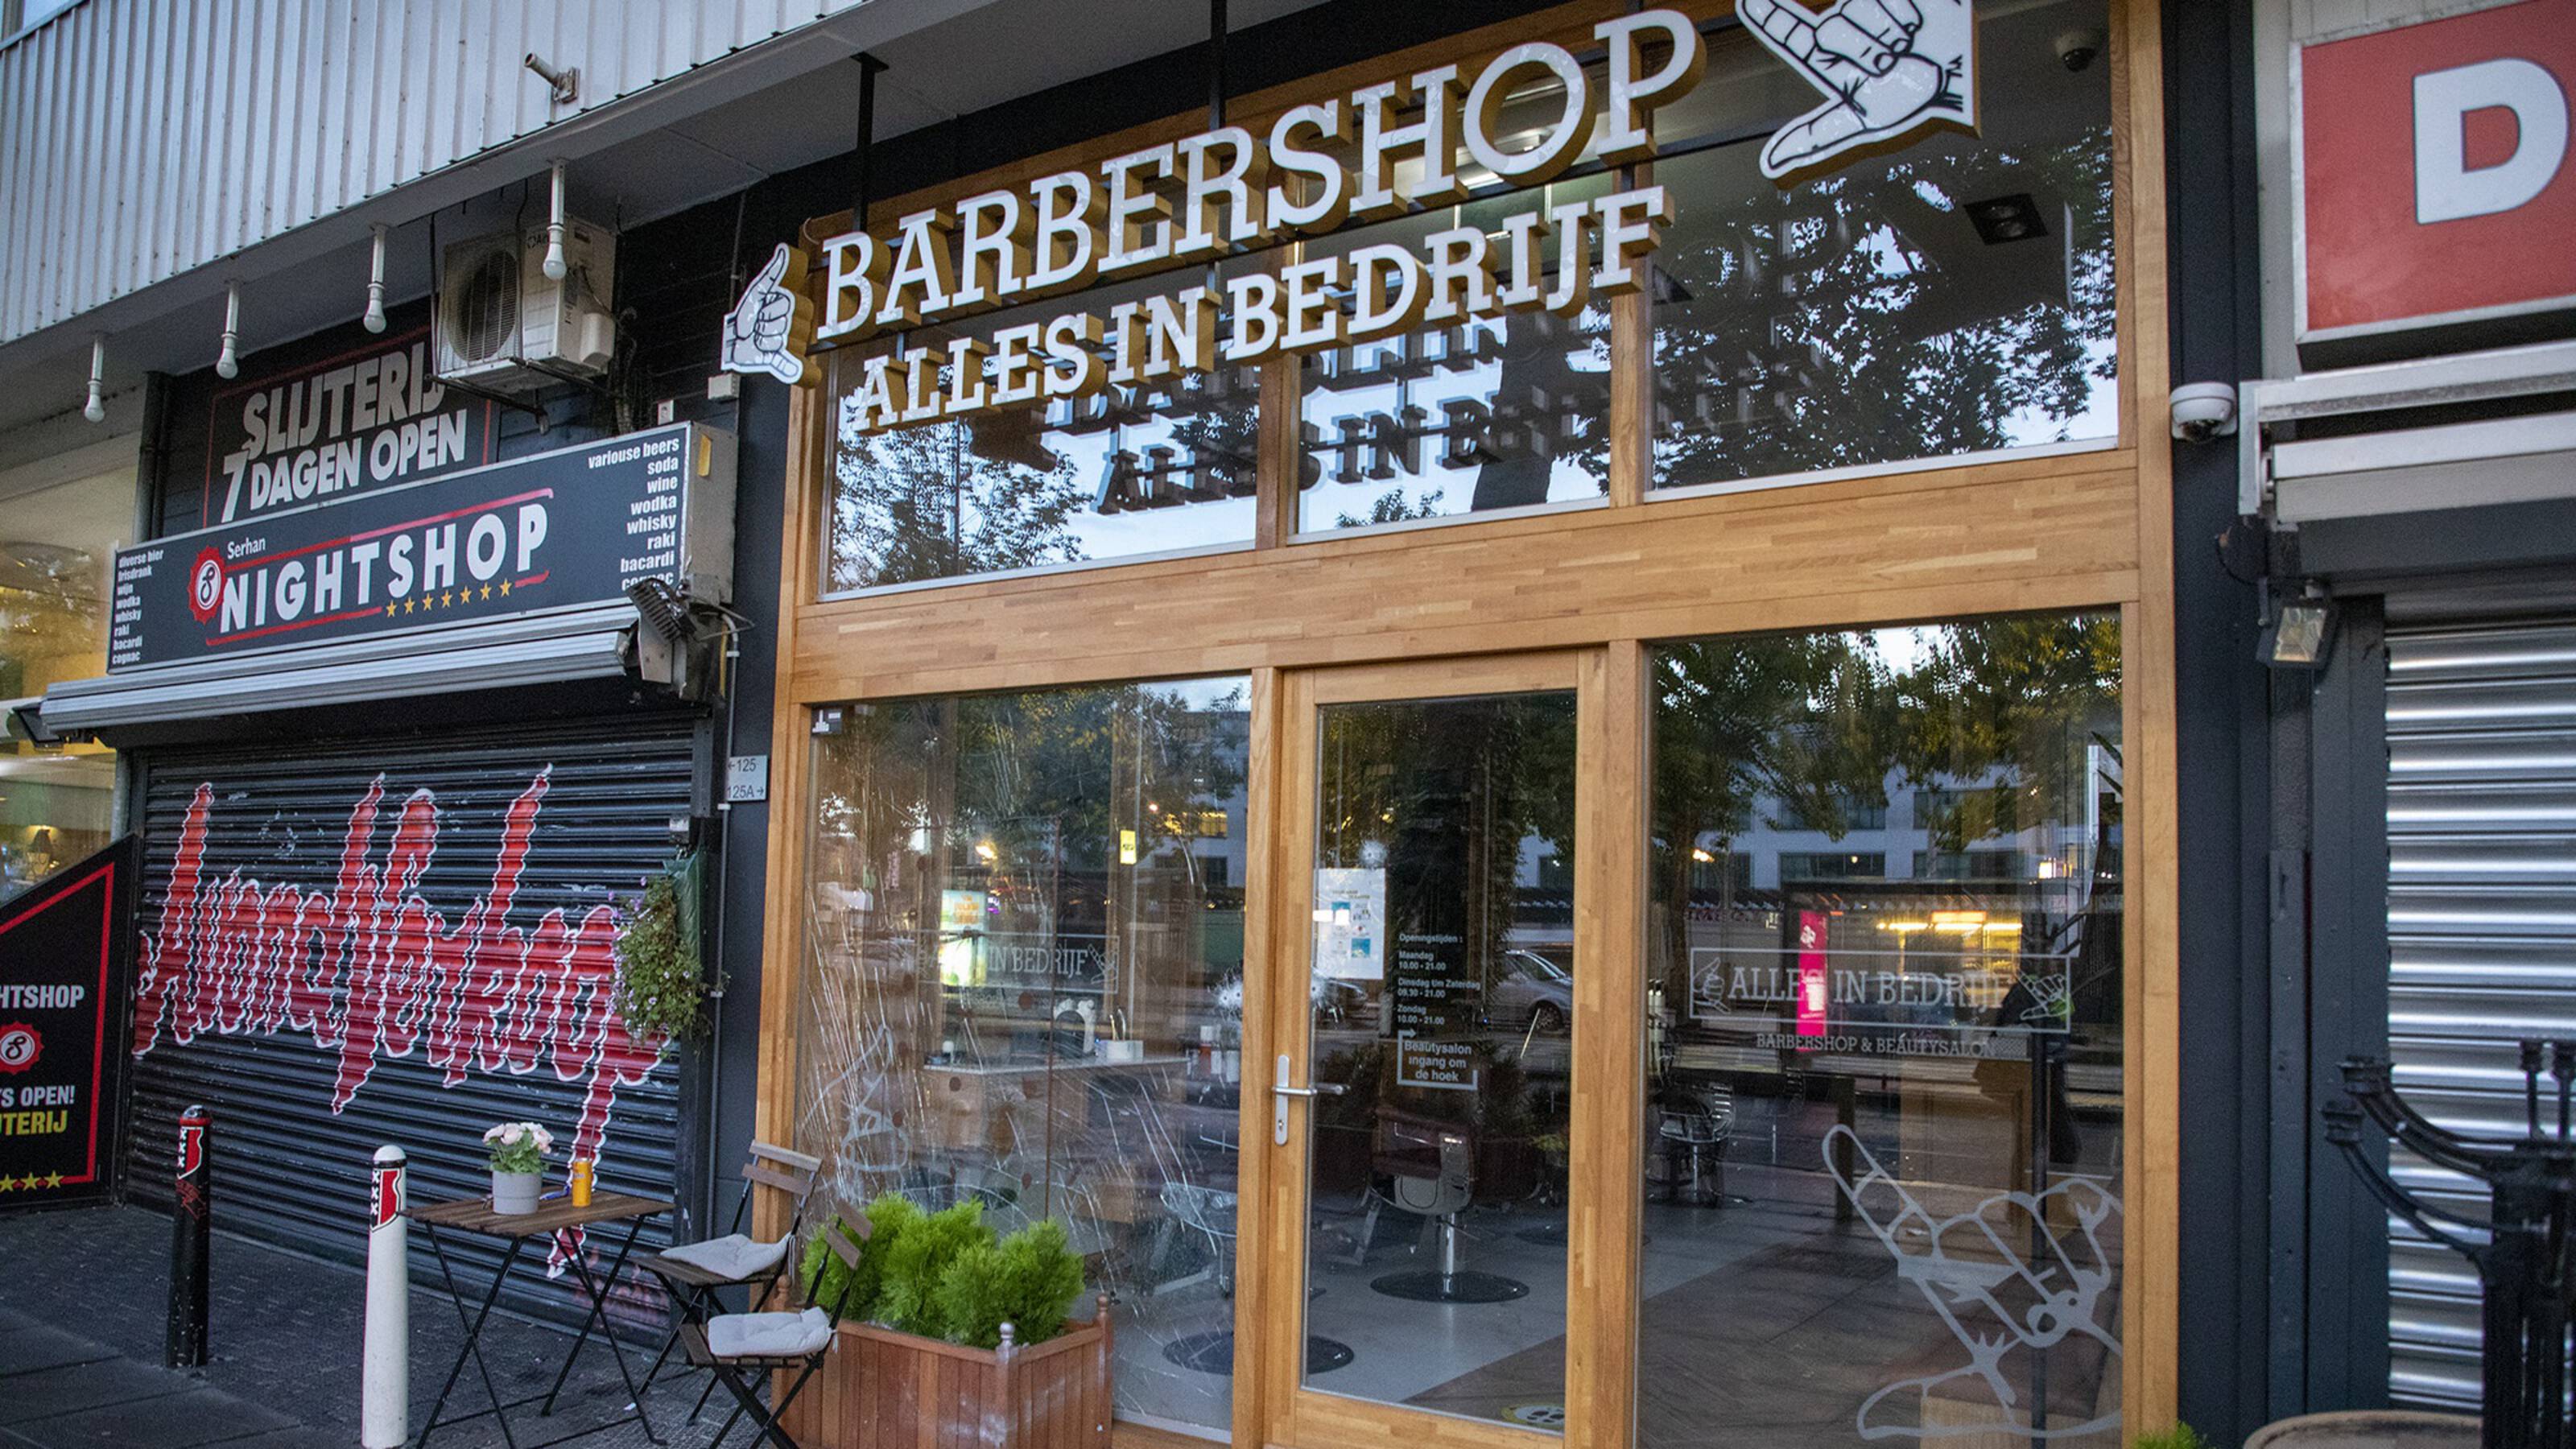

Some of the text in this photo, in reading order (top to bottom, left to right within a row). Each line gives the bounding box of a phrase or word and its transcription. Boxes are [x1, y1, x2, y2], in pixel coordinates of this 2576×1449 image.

[2411, 56, 2570, 225] D
[816, 9, 1697, 341] BARBERSHOP
[851, 185, 1665, 434] ALLES IN BEDRIJF
[588, 438, 680, 469] variouse beers
[221, 408, 468, 523] 7 DAGEN OPEN
[647, 456, 679, 476] soda
[646, 476, 678, 494] wine
[630, 495, 677, 515] wodka
[626, 514, 677, 535] whisky
[227, 537, 266, 559] Serhan
[646, 531, 675, 551] raki
[118, 549, 164, 568] diverse bier
[620, 551, 675, 573] bacardi
[118, 565, 153, 582] frisdrank
[220, 502, 549, 634] NIGHTSHOP
[117, 584, 134, 596] wijn
[116, 596, 141, 609] wodka
[115, 609, 142, 624] whisky
[114, 623, 130, 638] raki
[114, 635, 142, 650] bacardi
[113, 651, 141, 665] cognac
[737, 758, 757, 772] 125
[726, 784, 754, 799] 125A
[1399, 933, 1458, 944] Openingstijden
[1011, 946, 1088, 978] BEDRIJF
[1399, 952, 1435, 962] Maandag
[1399, 961, 1419, 970] 10.00
[1425, 962, 1447, 971] 21.00
[1398, 977, 1430, 989] Dinsdag
[1446, 979, 1481, 991] Zaterdag
[1834, 969, 1868, 1004] IN
[1876, 970, 2015, 1013] BEDRIJF
[1424, 989, 1446, 998] 21.00
[1397, 1004, 1426, 1015] Zondag
[1424, 1016, 1445, 1025] 21.00
[1404, 1040, 1472, 1055] Beautysalon
[1757, 1033, 1996, 1058] BARBERSHOP & BEAUTYSALON
[1409, 1055, 1467, 1070] ingang om
[1415, 1069, 1459, 1081] de hoek
[0, 1085, 76, 1108] S OPEN!
[0, 1109, 68, 1137] TERIJ
